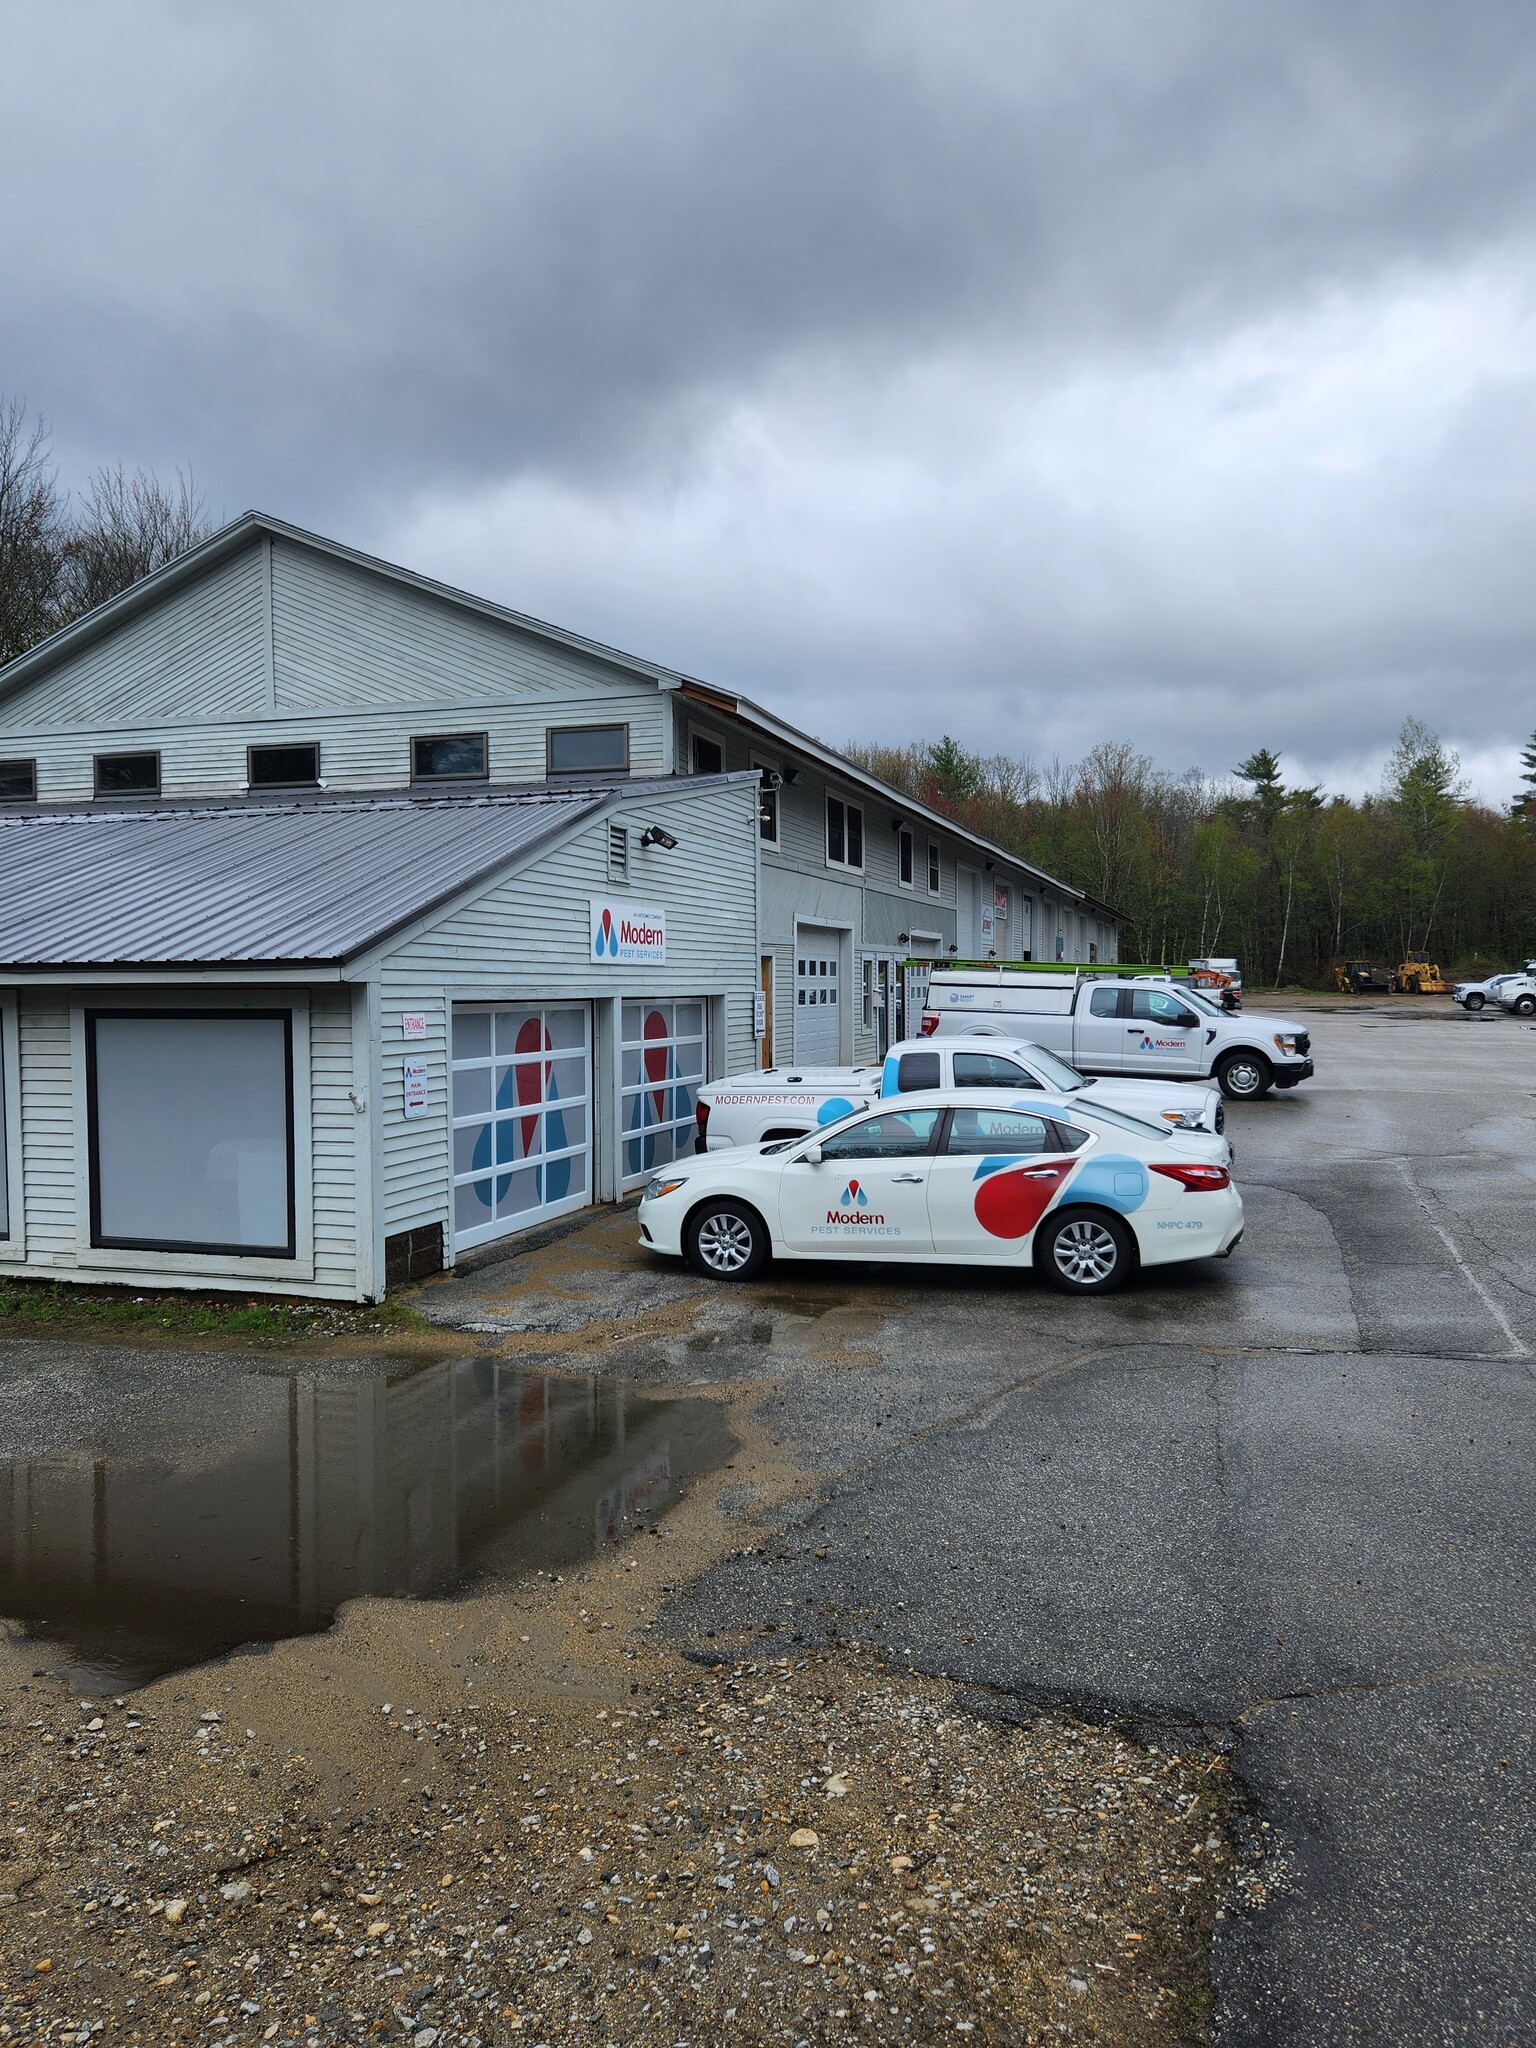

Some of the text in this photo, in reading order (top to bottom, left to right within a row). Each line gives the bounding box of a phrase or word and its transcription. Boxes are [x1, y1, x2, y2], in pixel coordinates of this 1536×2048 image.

[620, 920, 663, 946] Modern
[620, 949, 663, 959] PEST SERVICES
[404, 1017, 424, 1030] ENTRANCE
[1155, 1039, 1185, 1047] Modern
[715, 1095, 815, 1105] MODERNPEST.COM
[989, 1122, 1044, 1135] Modern
[826, 1211, 884, 1225] Modern
[1157, 1221, 1203, 1229] NHPC 479
[811, 1226, 901, 1235] PEST SERVICES
